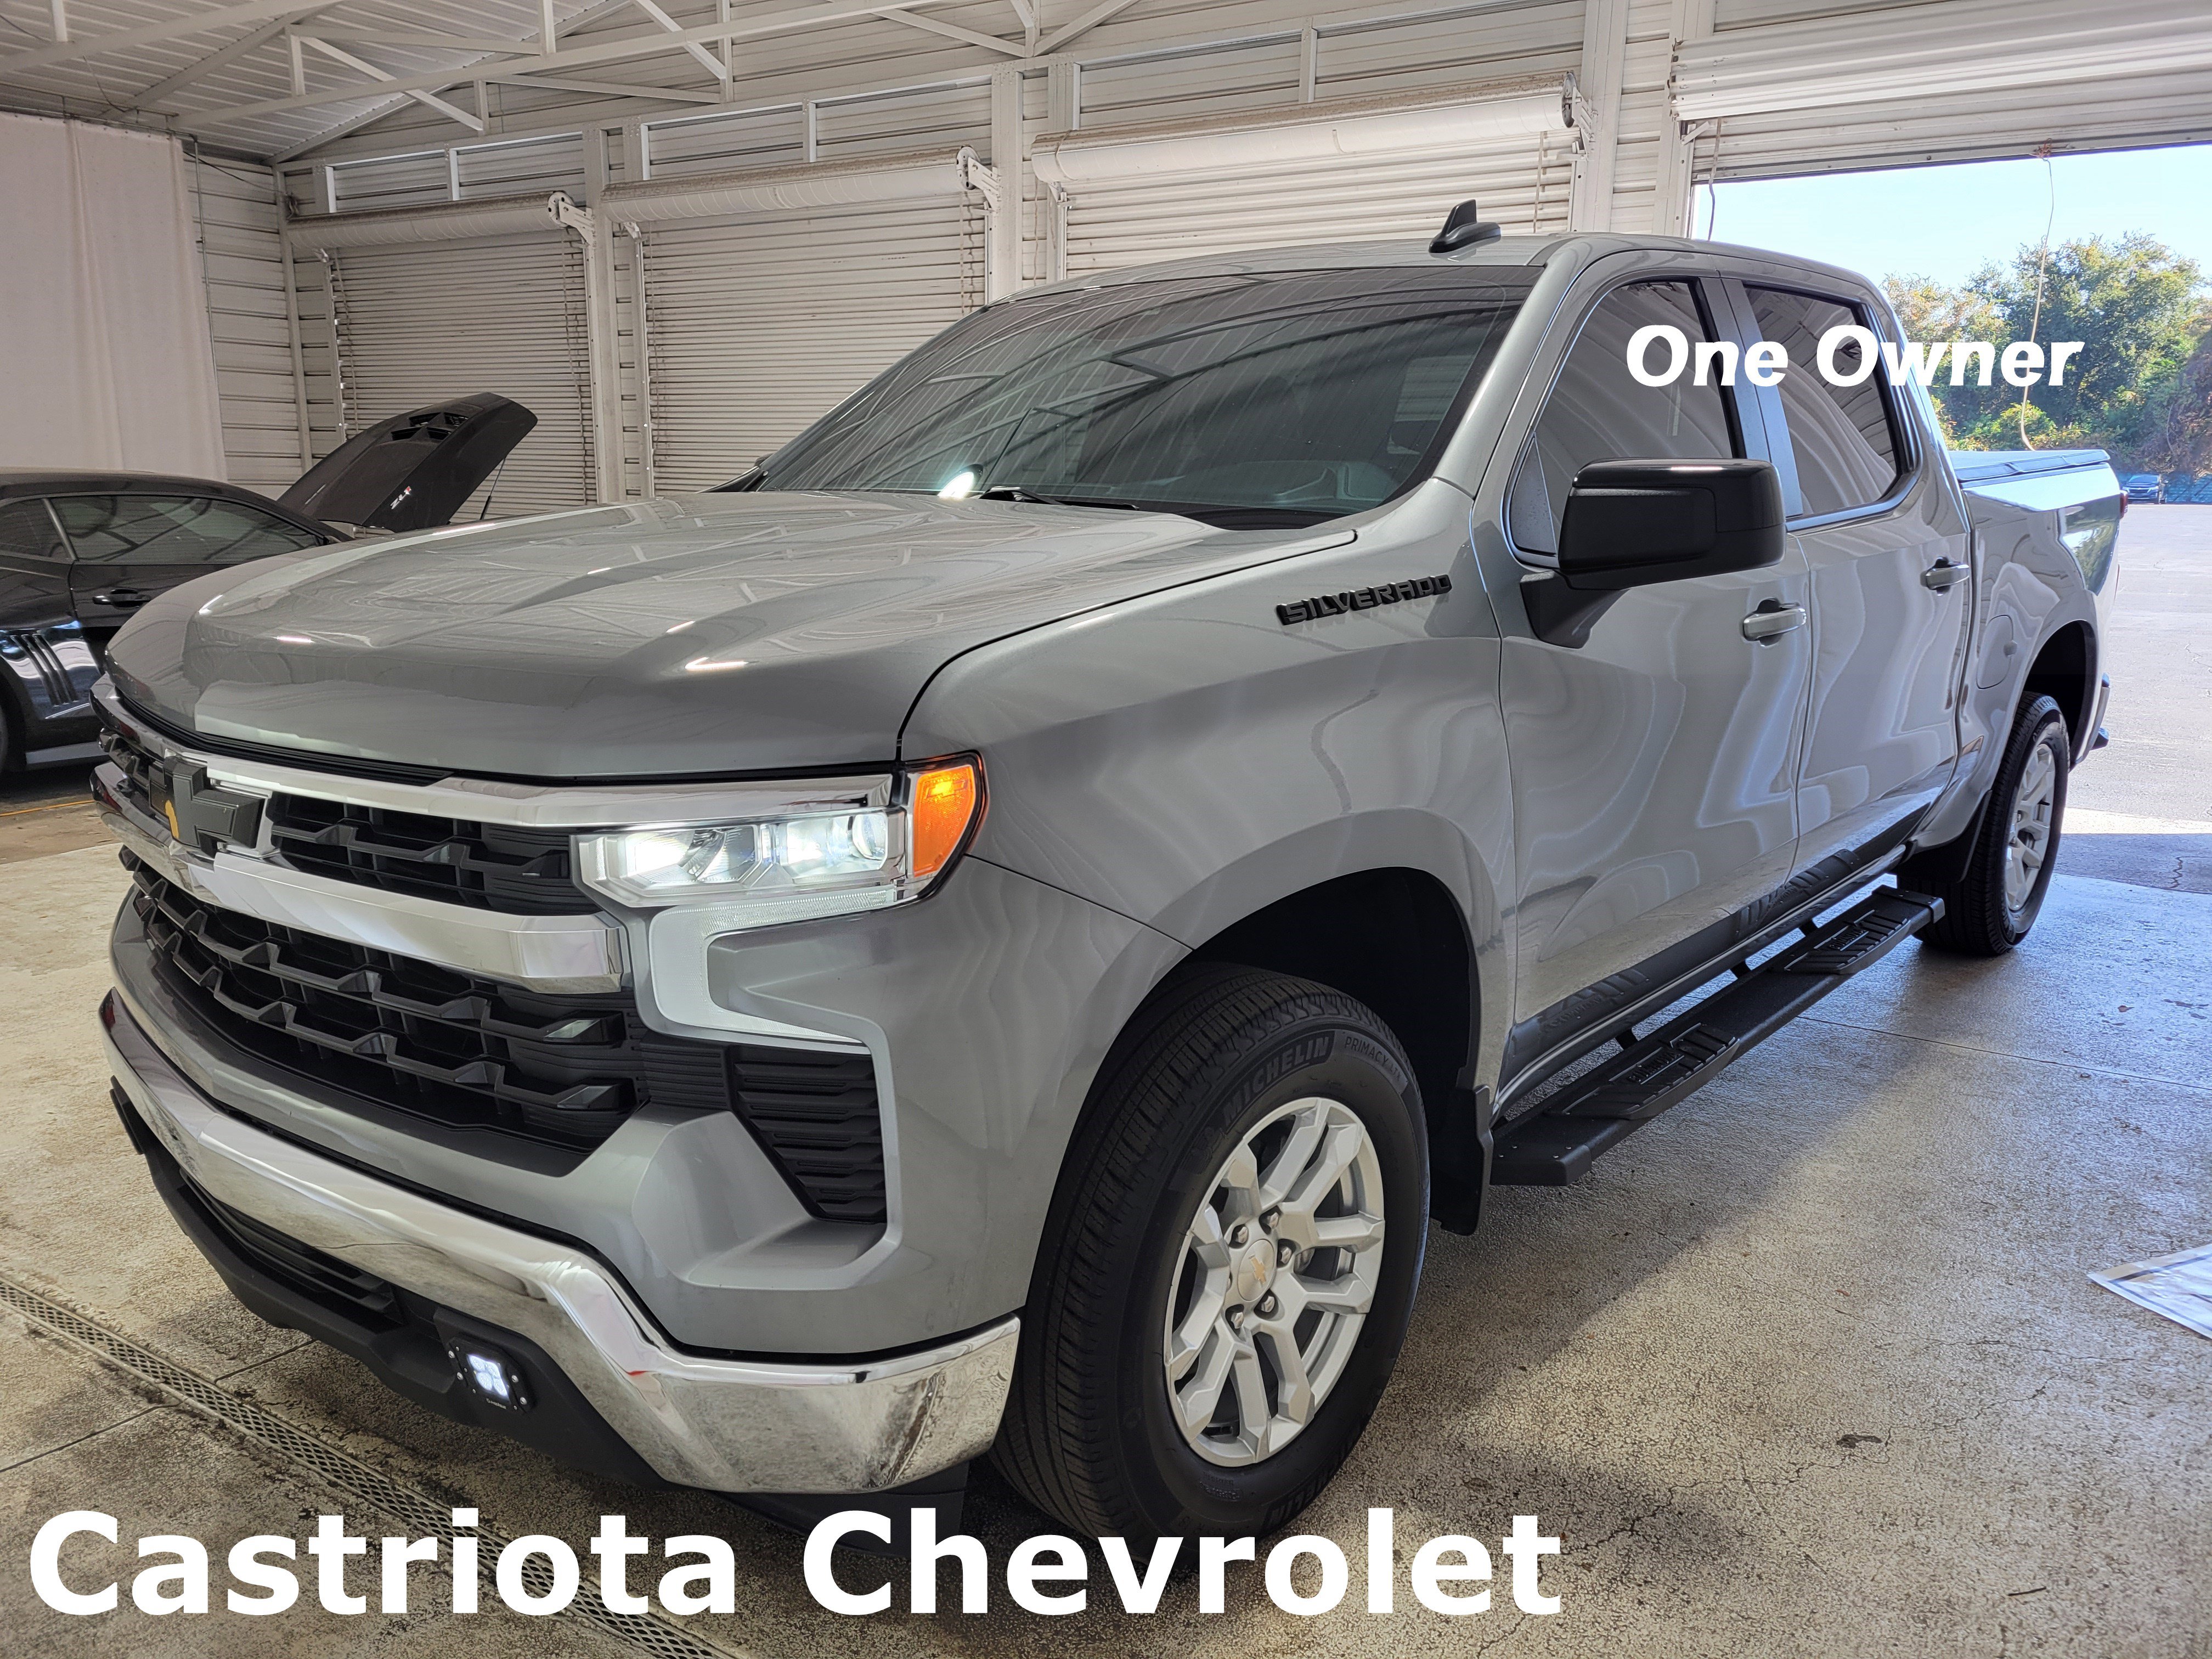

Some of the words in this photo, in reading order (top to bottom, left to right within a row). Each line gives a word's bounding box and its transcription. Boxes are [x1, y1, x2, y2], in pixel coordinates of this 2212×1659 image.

[1275, 574, 1452, 625] SILVERADO
[1222, 1035, 1330, 1127] MICHELIN
[1345, 1036, 1389, 1067] PRIMACY
